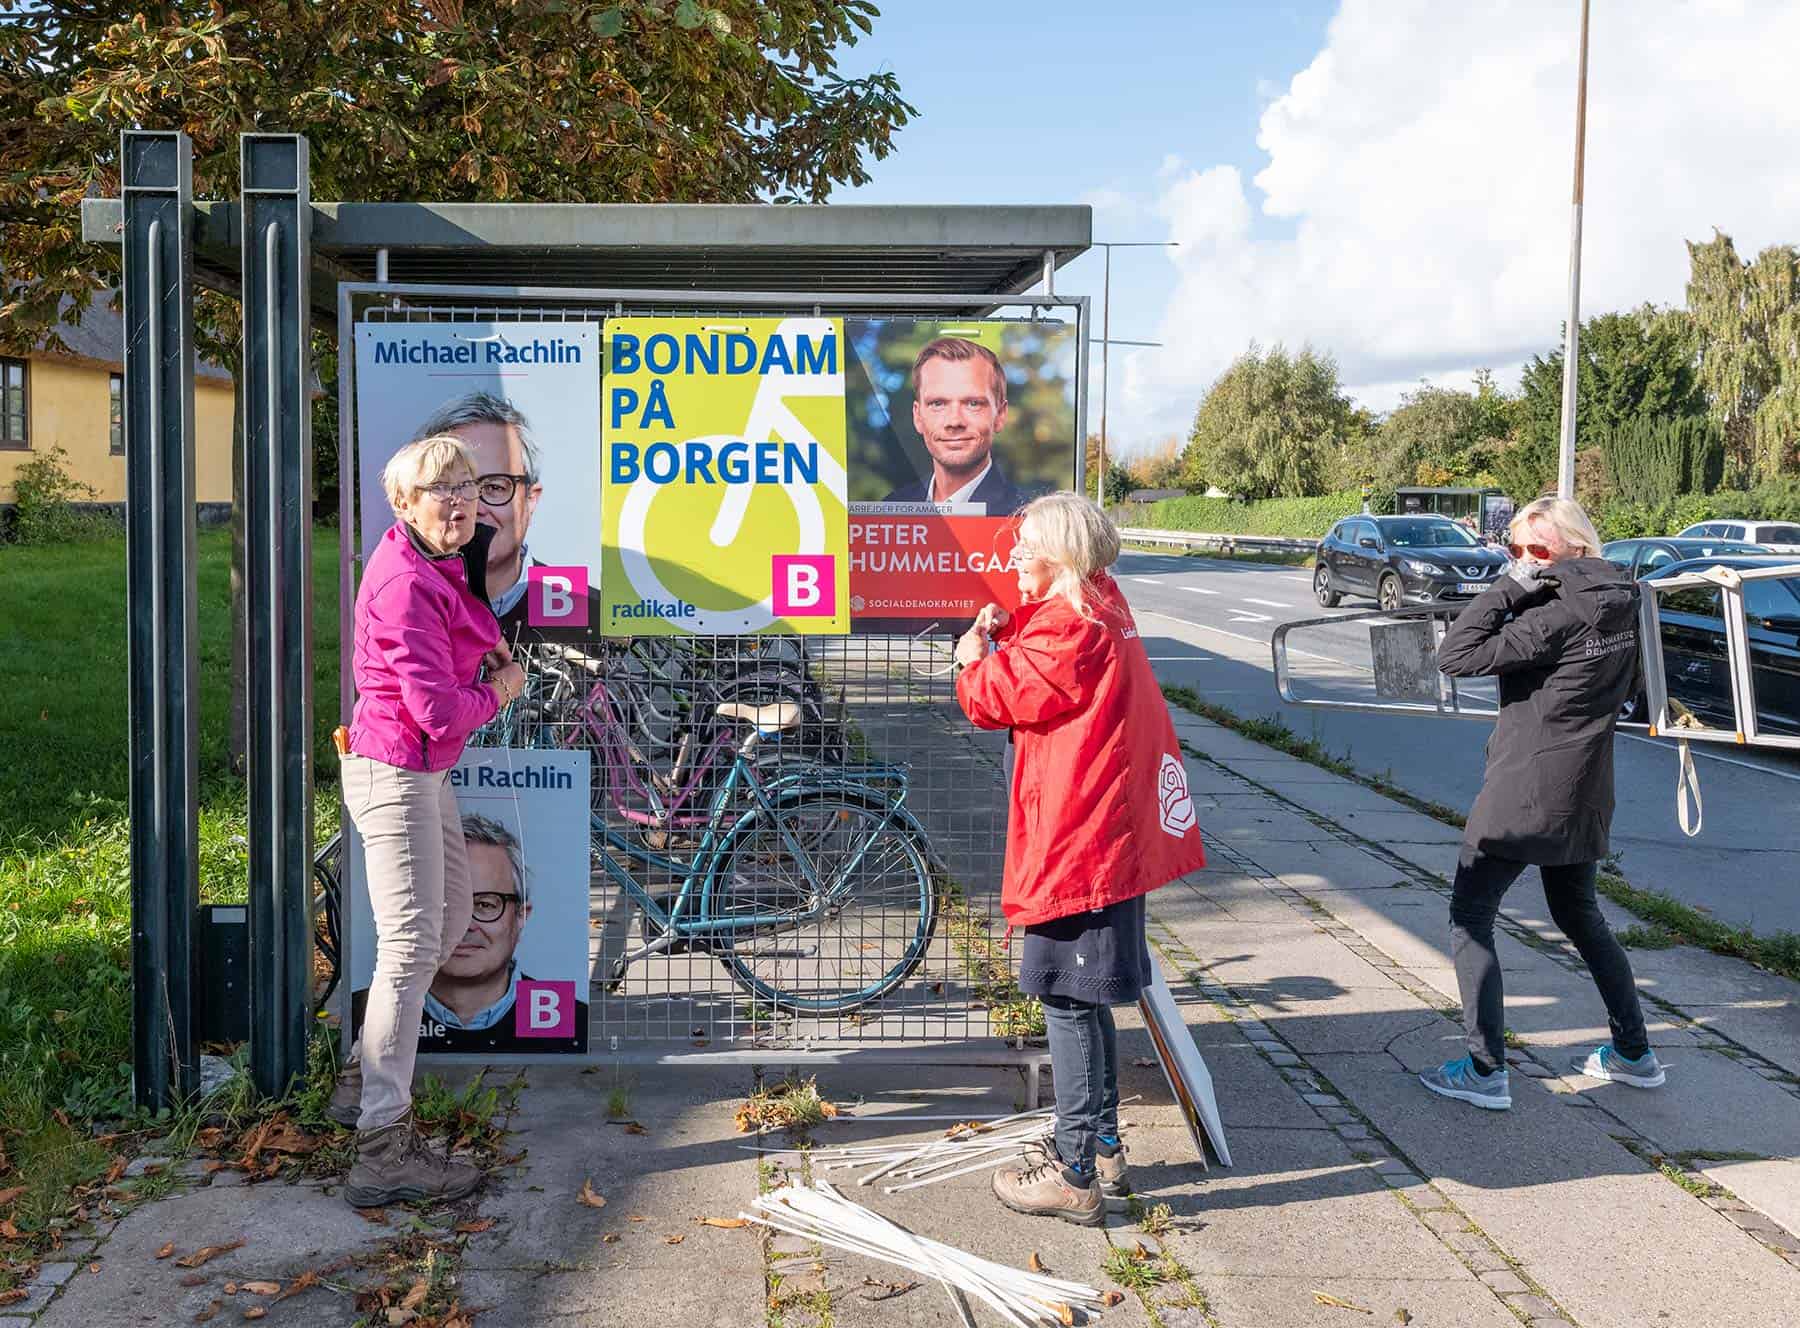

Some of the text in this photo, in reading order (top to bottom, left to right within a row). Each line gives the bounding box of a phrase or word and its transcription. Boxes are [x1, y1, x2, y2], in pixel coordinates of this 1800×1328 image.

[374, 339, 581, 364] Michael Rachlin
[611, 334, 837, 375] BONDAM
[611, 379, 676, 429] PÅ
[611, 442, 818, 484] BORGEN
[895, 504, 914, 514] FOR
[915, 503, 952, 514] AMAGER
[850, 524, 928, 545] PETER
[849, 551, 1023, 573] HUMMELGAA
[542, 575, 574, 618] B
[787, 564, 820, 607] B
[612, 599, 696, 618] radikale
[868, 599, 975, 609] SOCIALDEMOKRATIET
[478, 765, 573, 790] Rachlin
[530, 989, 561, 1029] B
